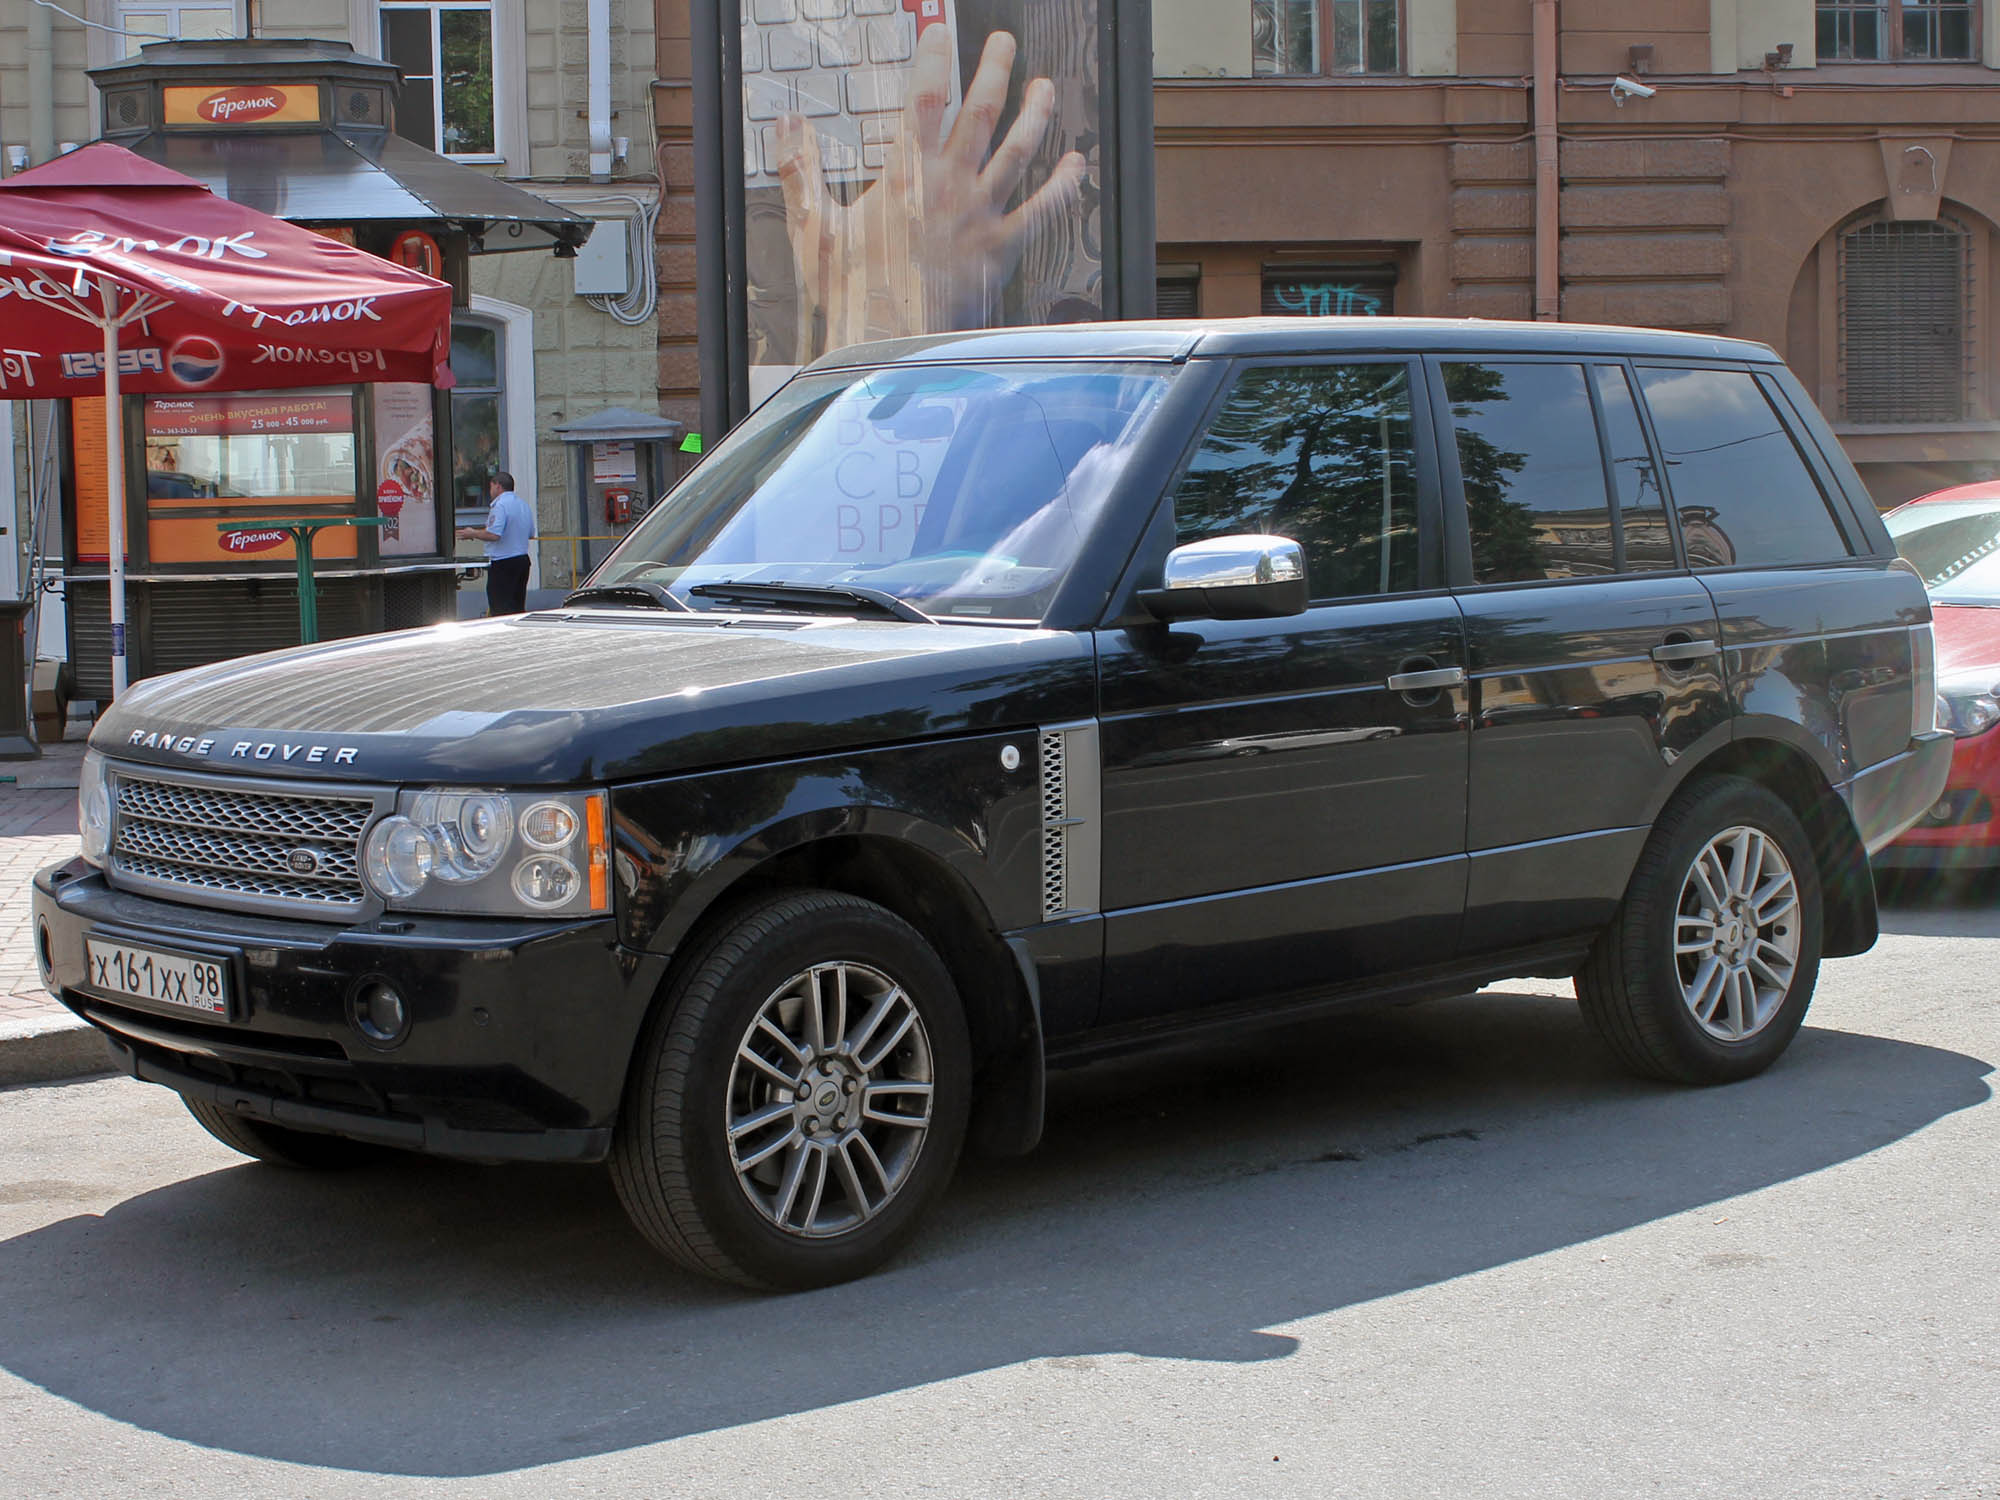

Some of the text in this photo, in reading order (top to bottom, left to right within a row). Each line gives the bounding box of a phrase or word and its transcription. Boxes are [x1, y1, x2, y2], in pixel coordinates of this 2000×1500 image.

[208, 97, 277, 119] Теремок
[188, 401, 327, 424] ОЧЕНЬ ВКУСНАЯ РАБОТА!
[251, 419, 264, 429] 25
[286, 416, 299, 427] 45
[227, 531, 283, 549] Теремок
[127, 728, 359, 764] RANGE ROVER
[193, 963, 220, 997] 98
[194, 995, 213, 1009] RUS
